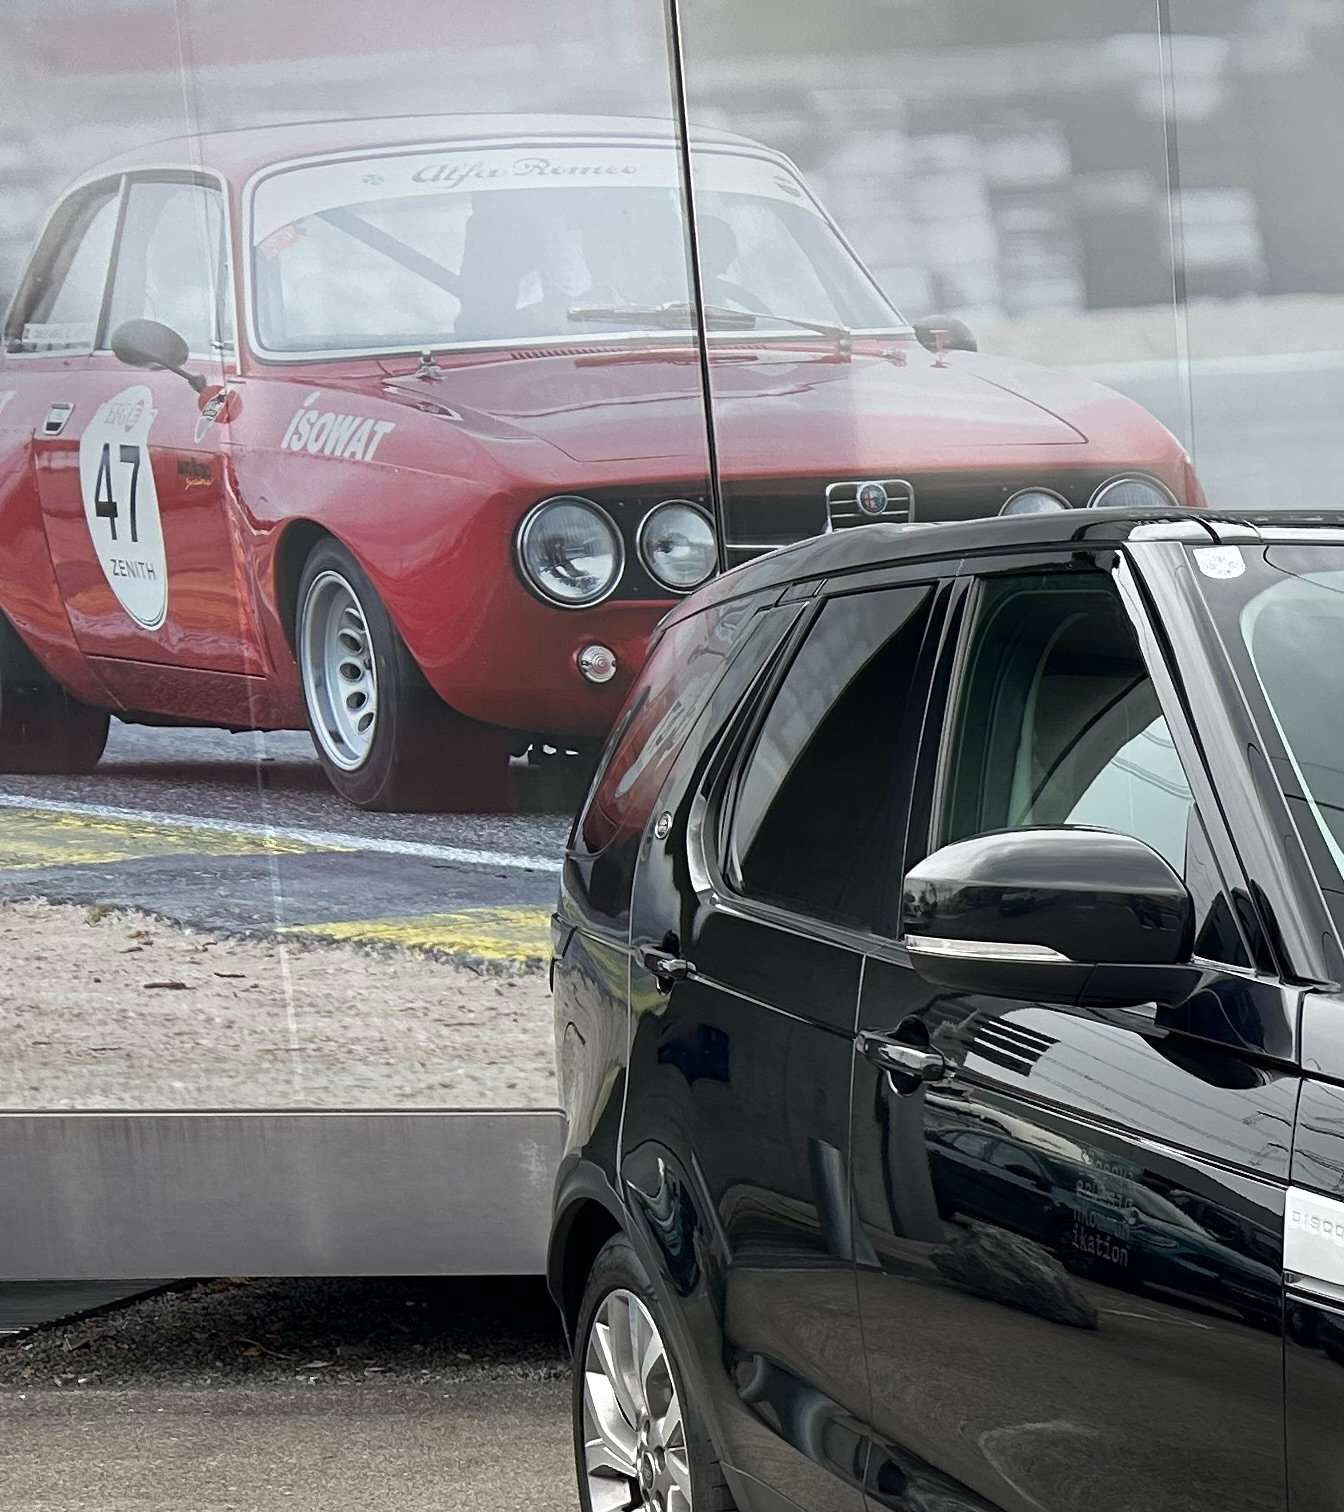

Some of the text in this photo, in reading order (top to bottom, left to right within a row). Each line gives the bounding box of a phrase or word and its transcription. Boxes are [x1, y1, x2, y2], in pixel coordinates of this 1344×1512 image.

[411, 158, 639, 190] Alfa Romeo
[94, 443, 141, 543] 47
[110, 558, 157, 581] ZENITH
